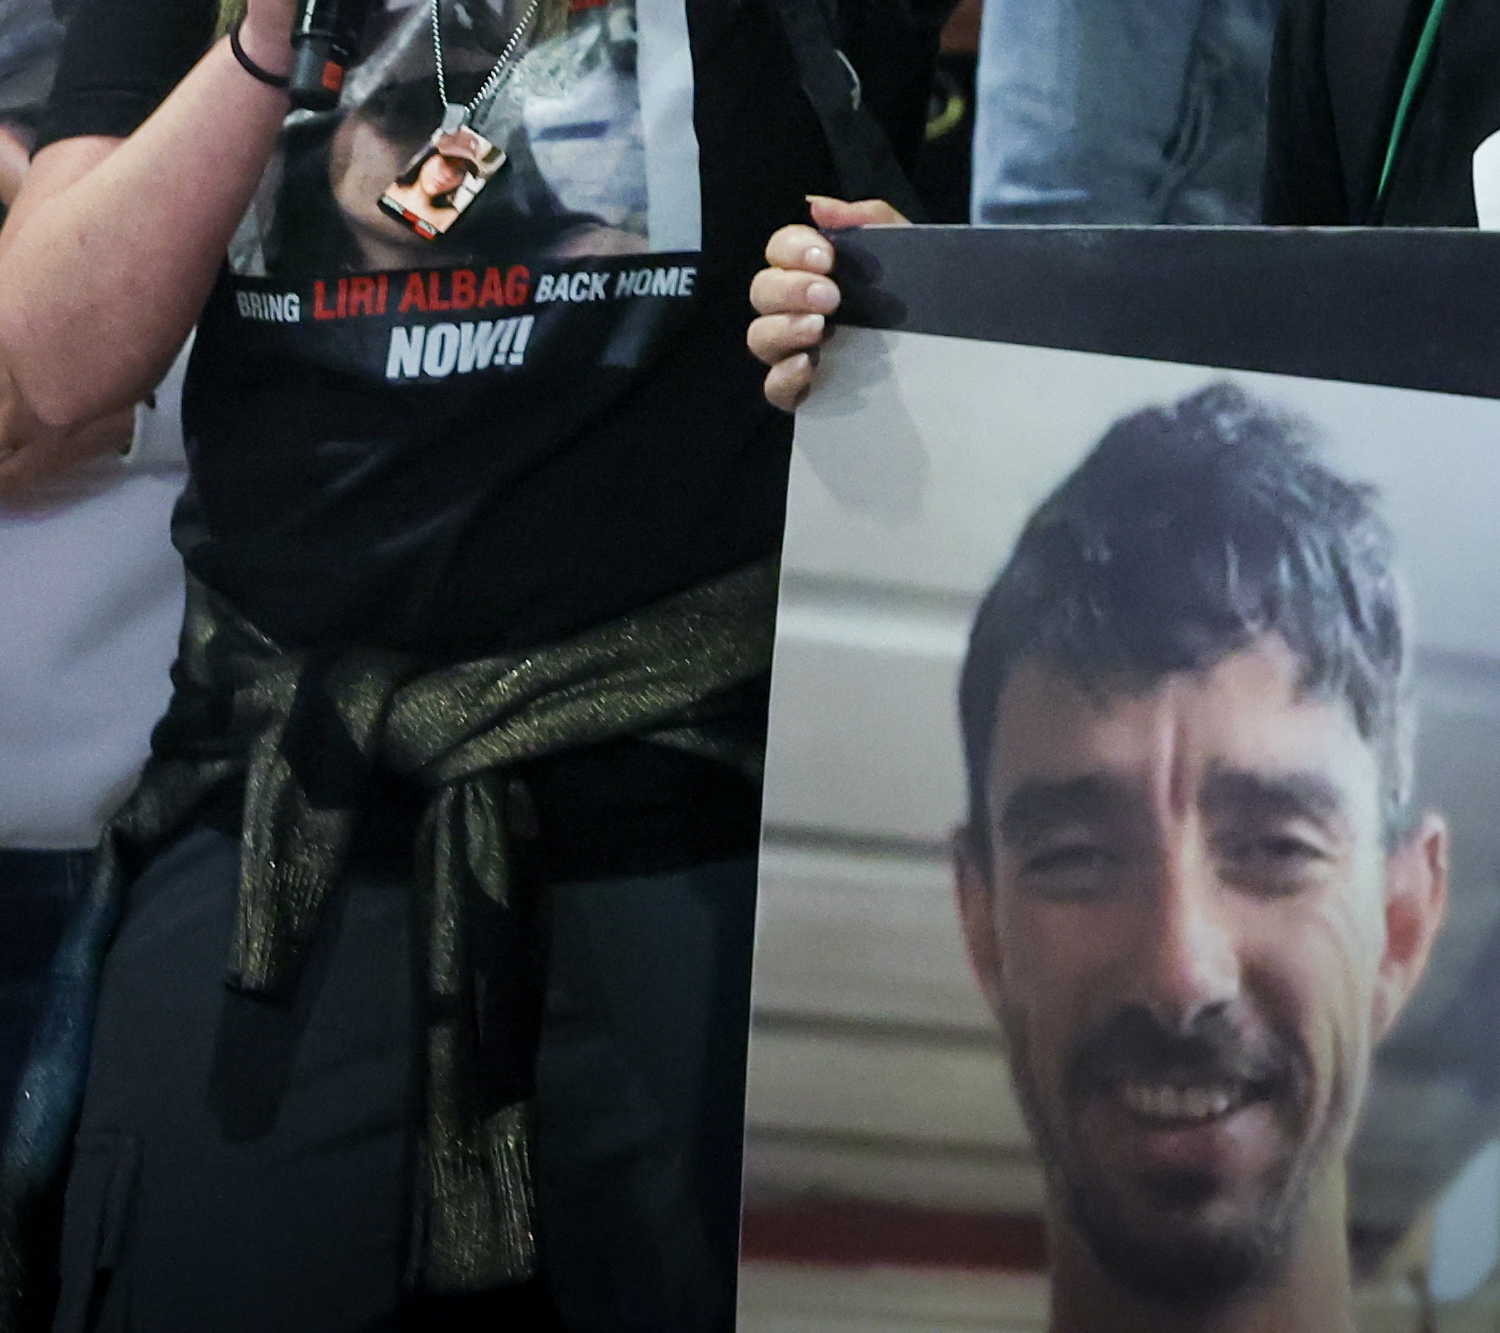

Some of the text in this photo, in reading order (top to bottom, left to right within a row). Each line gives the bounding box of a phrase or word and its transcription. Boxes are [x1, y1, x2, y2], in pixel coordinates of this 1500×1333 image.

[235, 265, 697, 323] BRING LIRI ALBAG BACK HOME
[386, 315, 534, 381] NOW!!
